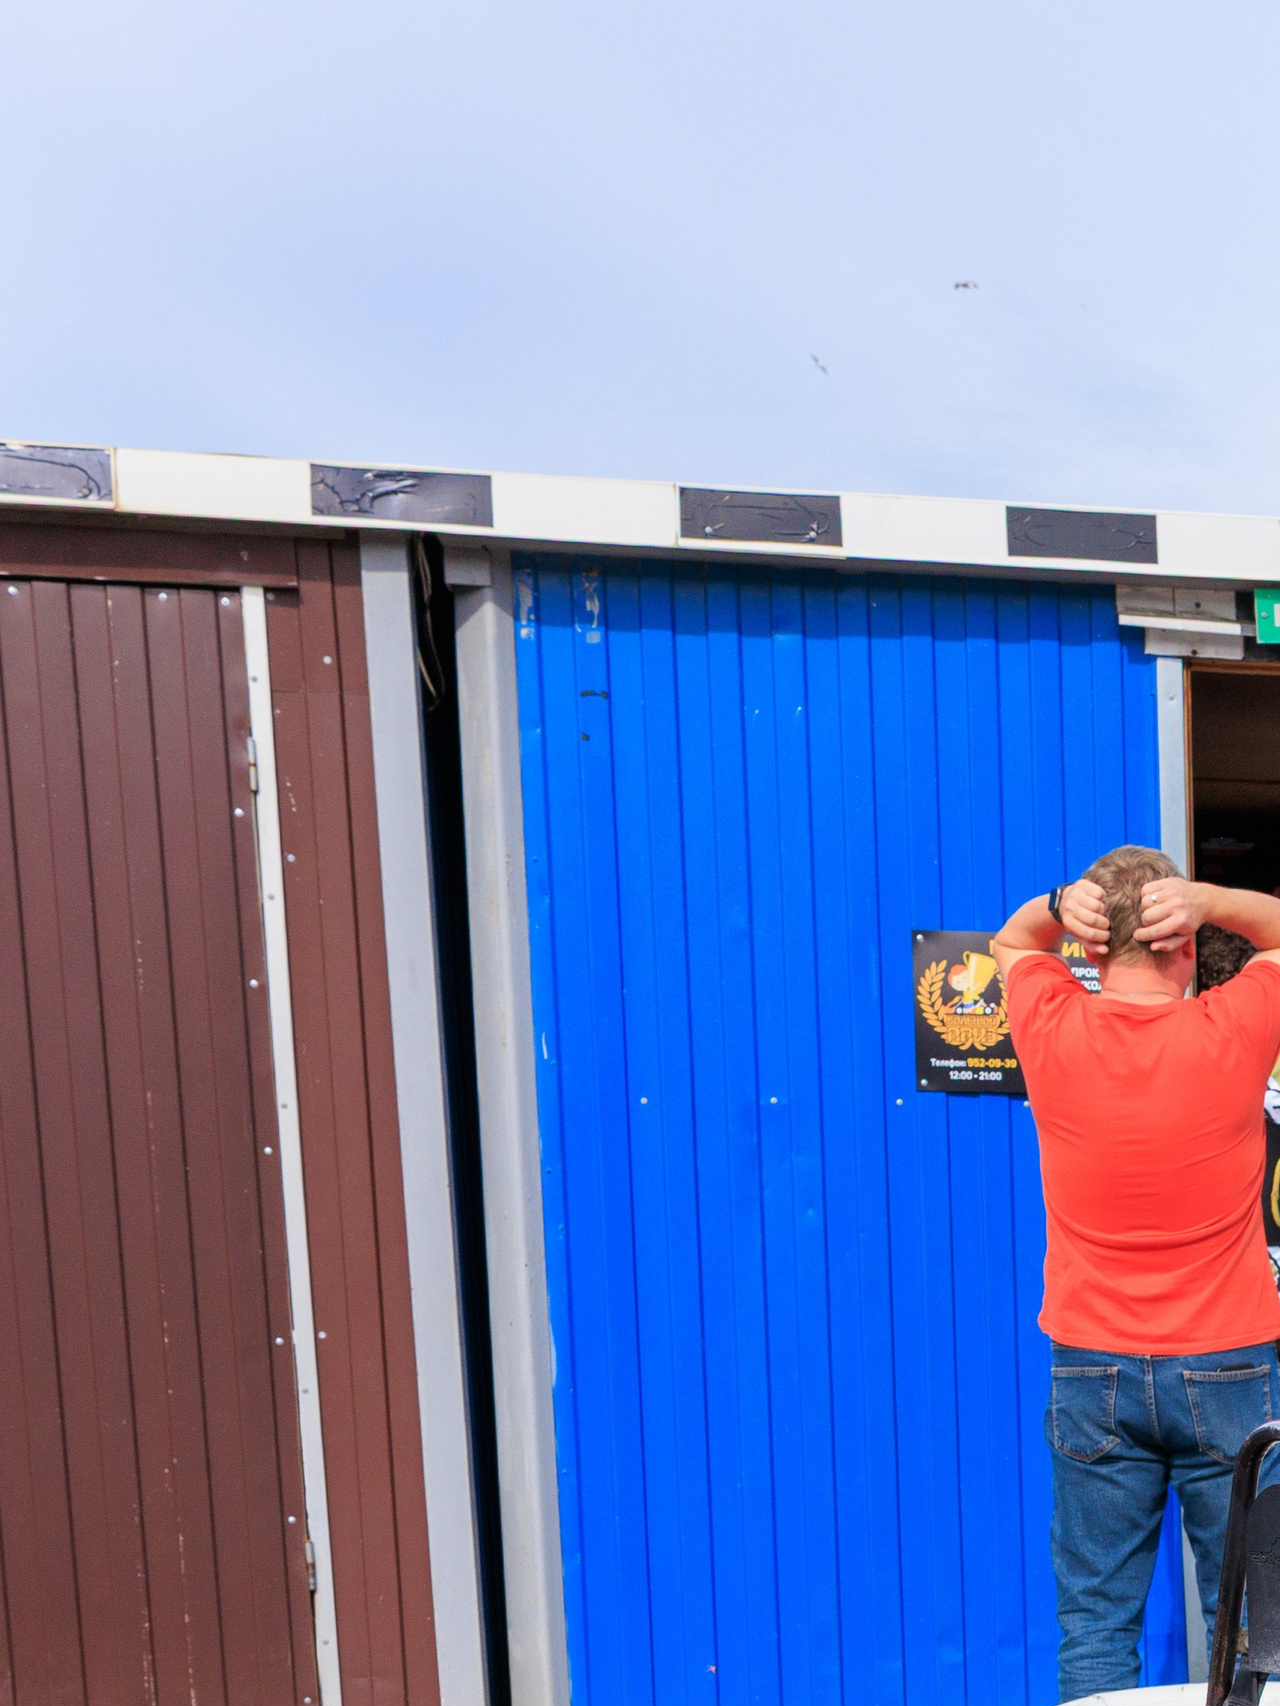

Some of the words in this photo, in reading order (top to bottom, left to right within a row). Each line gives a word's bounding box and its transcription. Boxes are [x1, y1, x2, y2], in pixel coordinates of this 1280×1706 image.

[1071, 967, 1100, 978] ПРОК
[967, 1057, 1018, 1068] 952-09-39
[949, 1070, 973, 1080] 12:00
[978, 1071, 1003, 1081] 21:00
